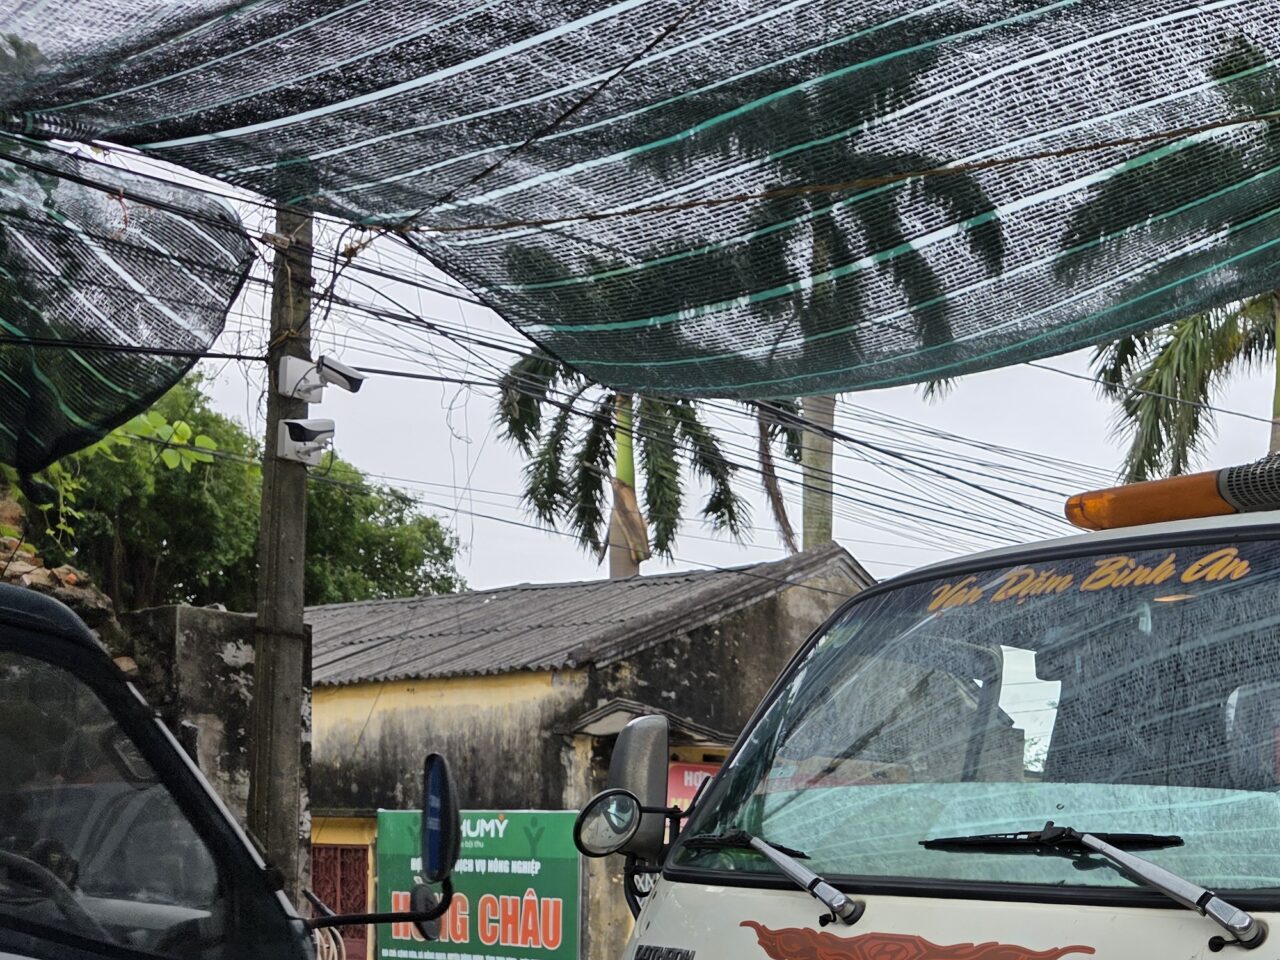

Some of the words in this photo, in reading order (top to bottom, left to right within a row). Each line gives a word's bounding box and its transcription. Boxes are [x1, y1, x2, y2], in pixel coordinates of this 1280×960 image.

[1080, 555, 1177, 592] Bình
[1181, 547, 1250, 587] An
[478, 888, 563, 951] CHÂU
